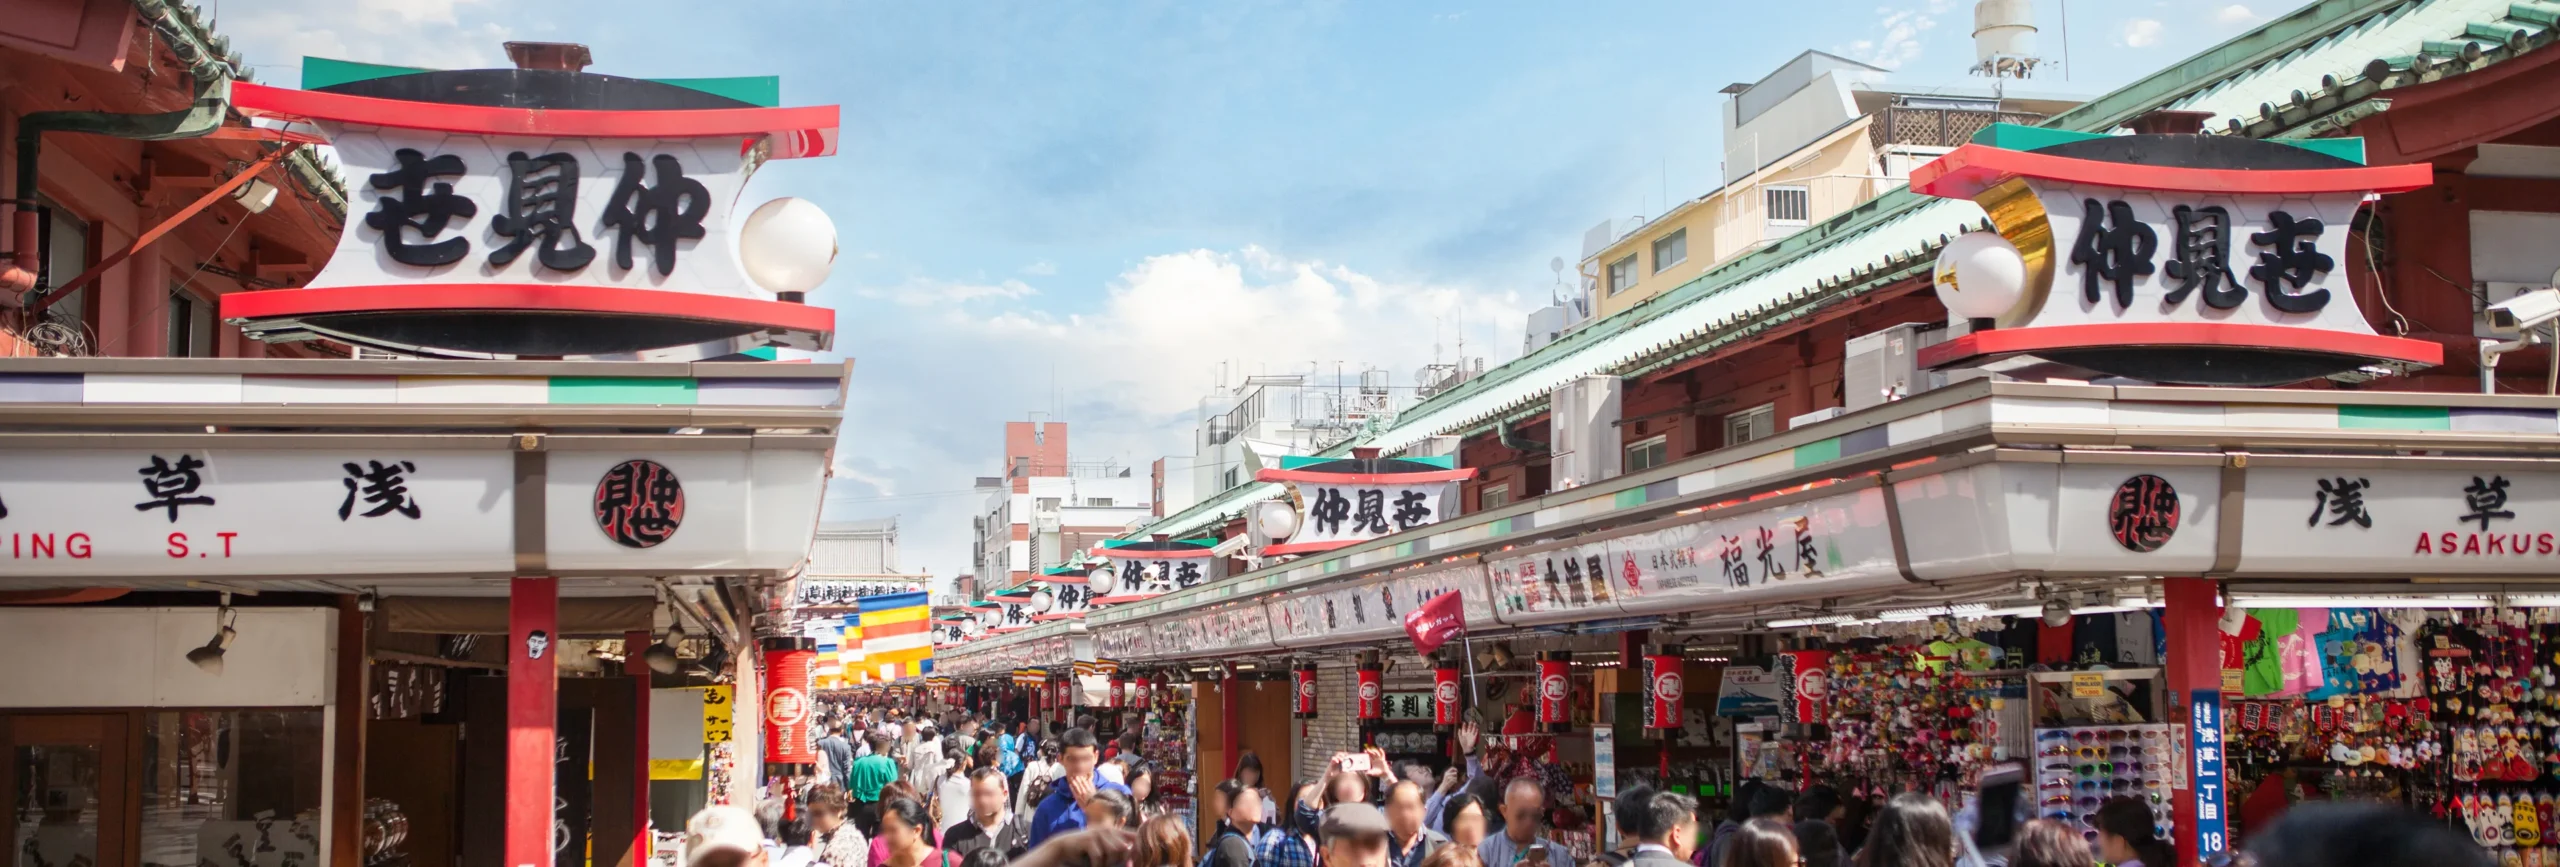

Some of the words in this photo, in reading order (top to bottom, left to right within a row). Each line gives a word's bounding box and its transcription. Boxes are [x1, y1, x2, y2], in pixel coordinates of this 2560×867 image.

[0, 455, 421, 522] 浅草
[0, 533, 92, 558] ING
[1719, 516, 1824, 589] 福光屋
[2415, 532, 2560, 556] ASAKUS
[2201, 727, 2220, 819] 浅草一丁目
[2202, 831, 2222, 852] 18
